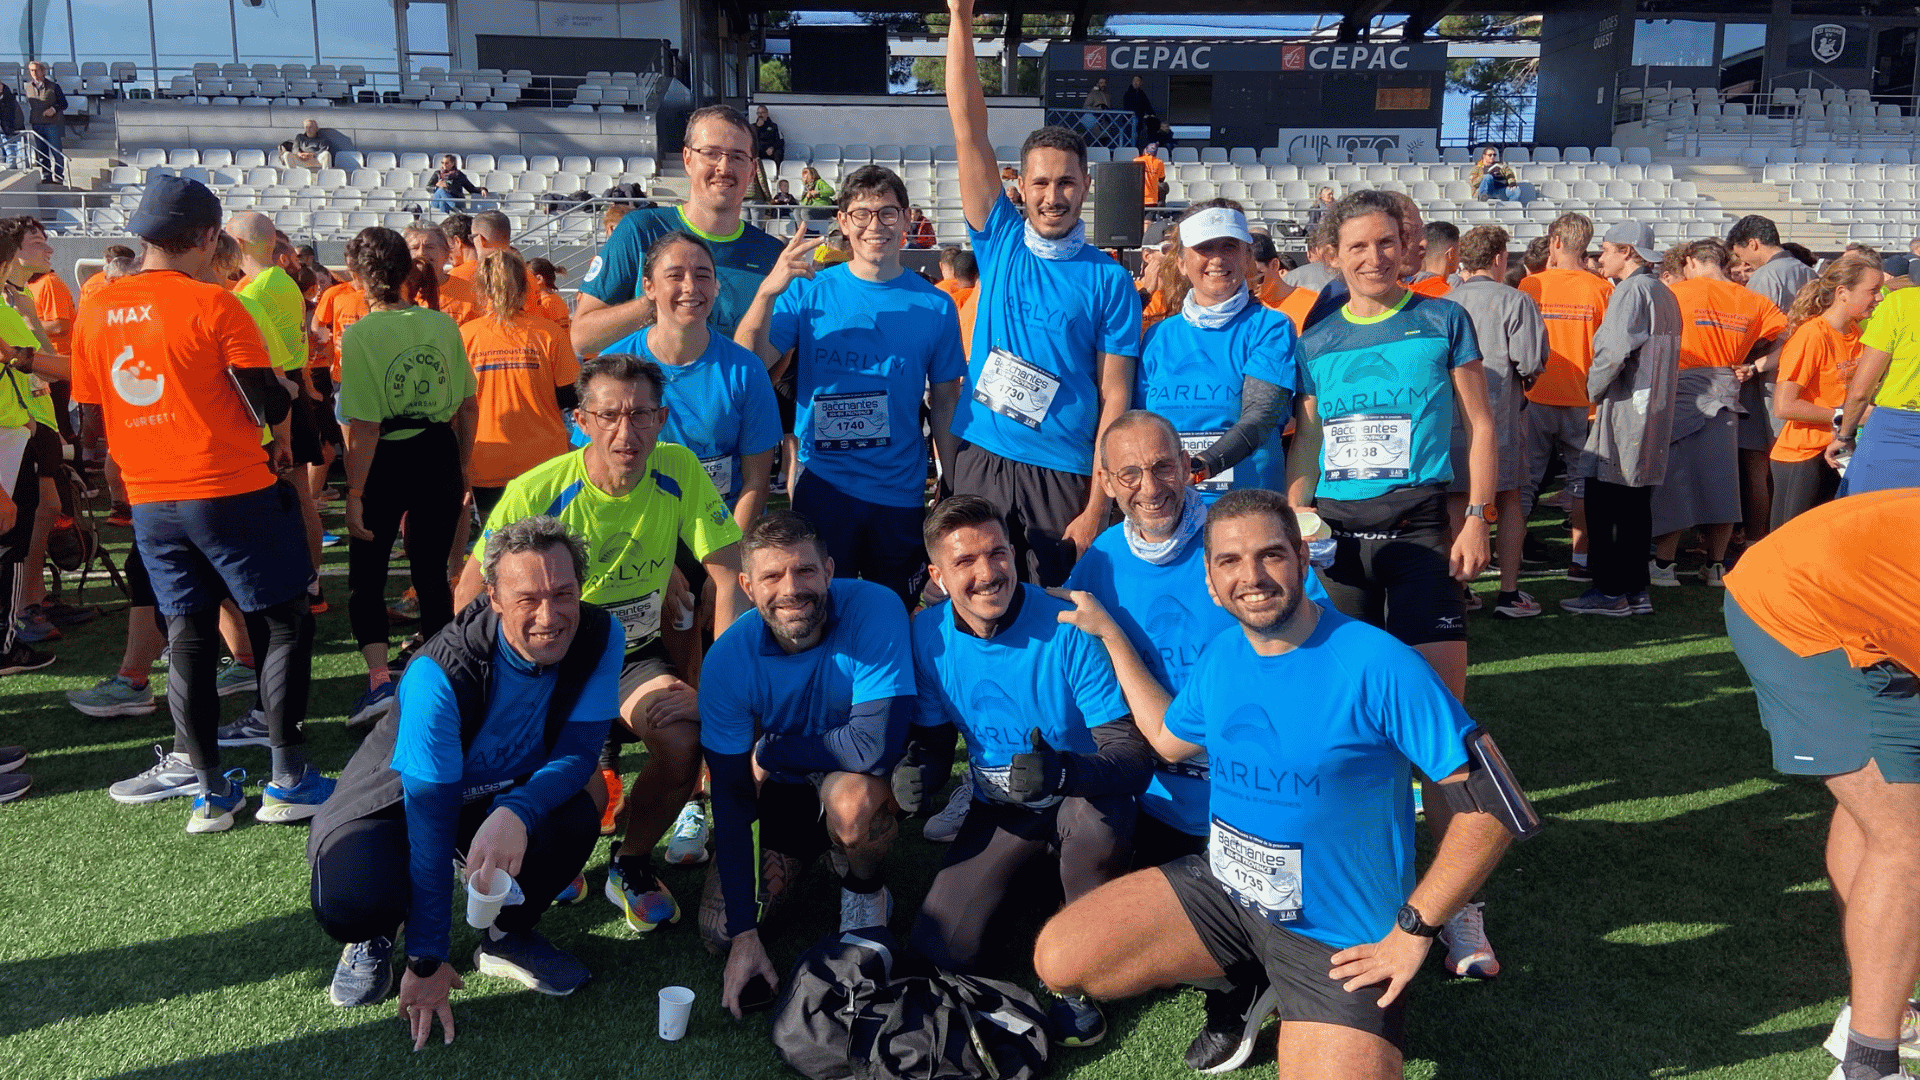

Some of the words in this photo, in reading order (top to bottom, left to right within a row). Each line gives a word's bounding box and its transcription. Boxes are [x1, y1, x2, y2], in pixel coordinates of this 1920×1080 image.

[1110, 46, 1211, 69] CEPAC
[1308, 46, 1410, 69] CEPAC
[107, 305, 152, 326] MAX
[815, 348, 905, 375] PARLYM
[393, 373, 406, 398] LES
[999, 384, 1025, 401] 1730
[1322, 387, 1428, 417] PARLYM
[837, 421, 864, 430] 1740
[1331, 424, 1398, 436] Baccantes
[1346, 447, 1377, 457] 1738
[1219, 831, 1286, 866] Bacchantes
[1235, 868, 1263, 891] 1735
